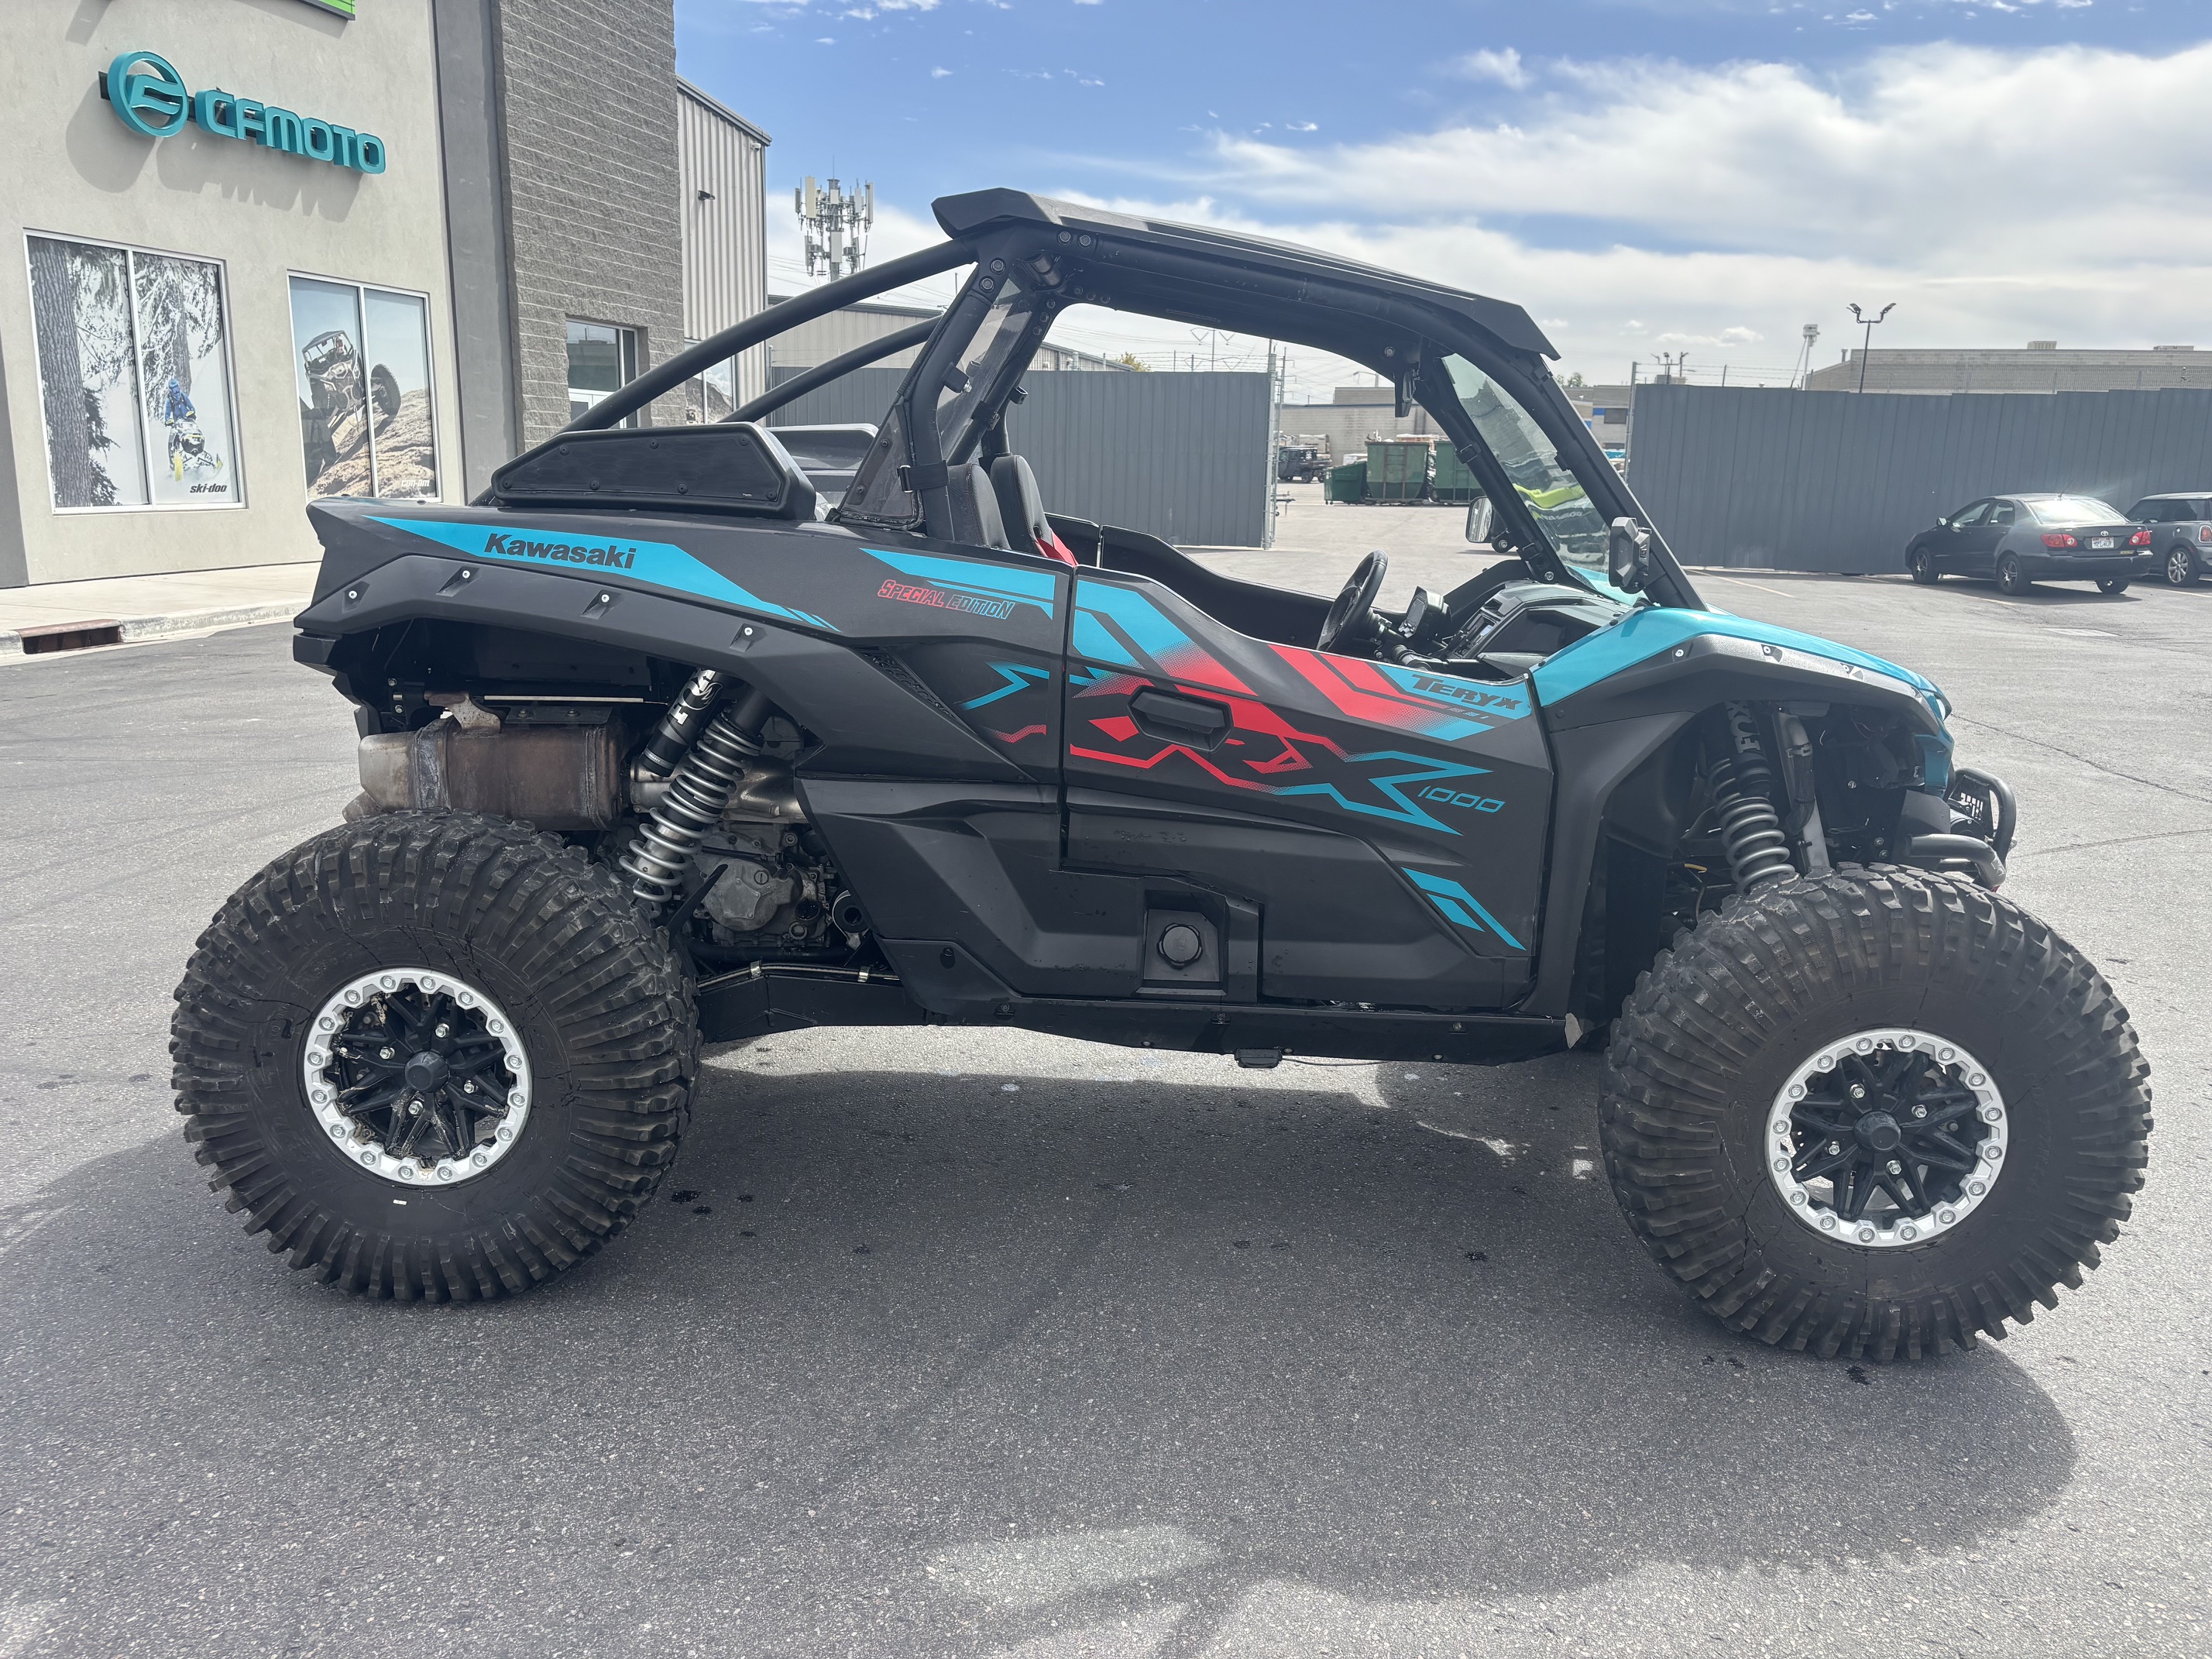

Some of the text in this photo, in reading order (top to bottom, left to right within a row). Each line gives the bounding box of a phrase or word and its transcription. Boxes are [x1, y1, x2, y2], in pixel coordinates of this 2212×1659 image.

[194, 89, 386, 175] CFMOTO
[190, 483, 227, 493] ski-doo
[484, 533, 637, 569] Kawasaki
[877, 579, 1016, 620] SPECIAL EDITION
[1412, 675, 1523, 710] TERYX
[1417, 785, 1506, 813] 1000
